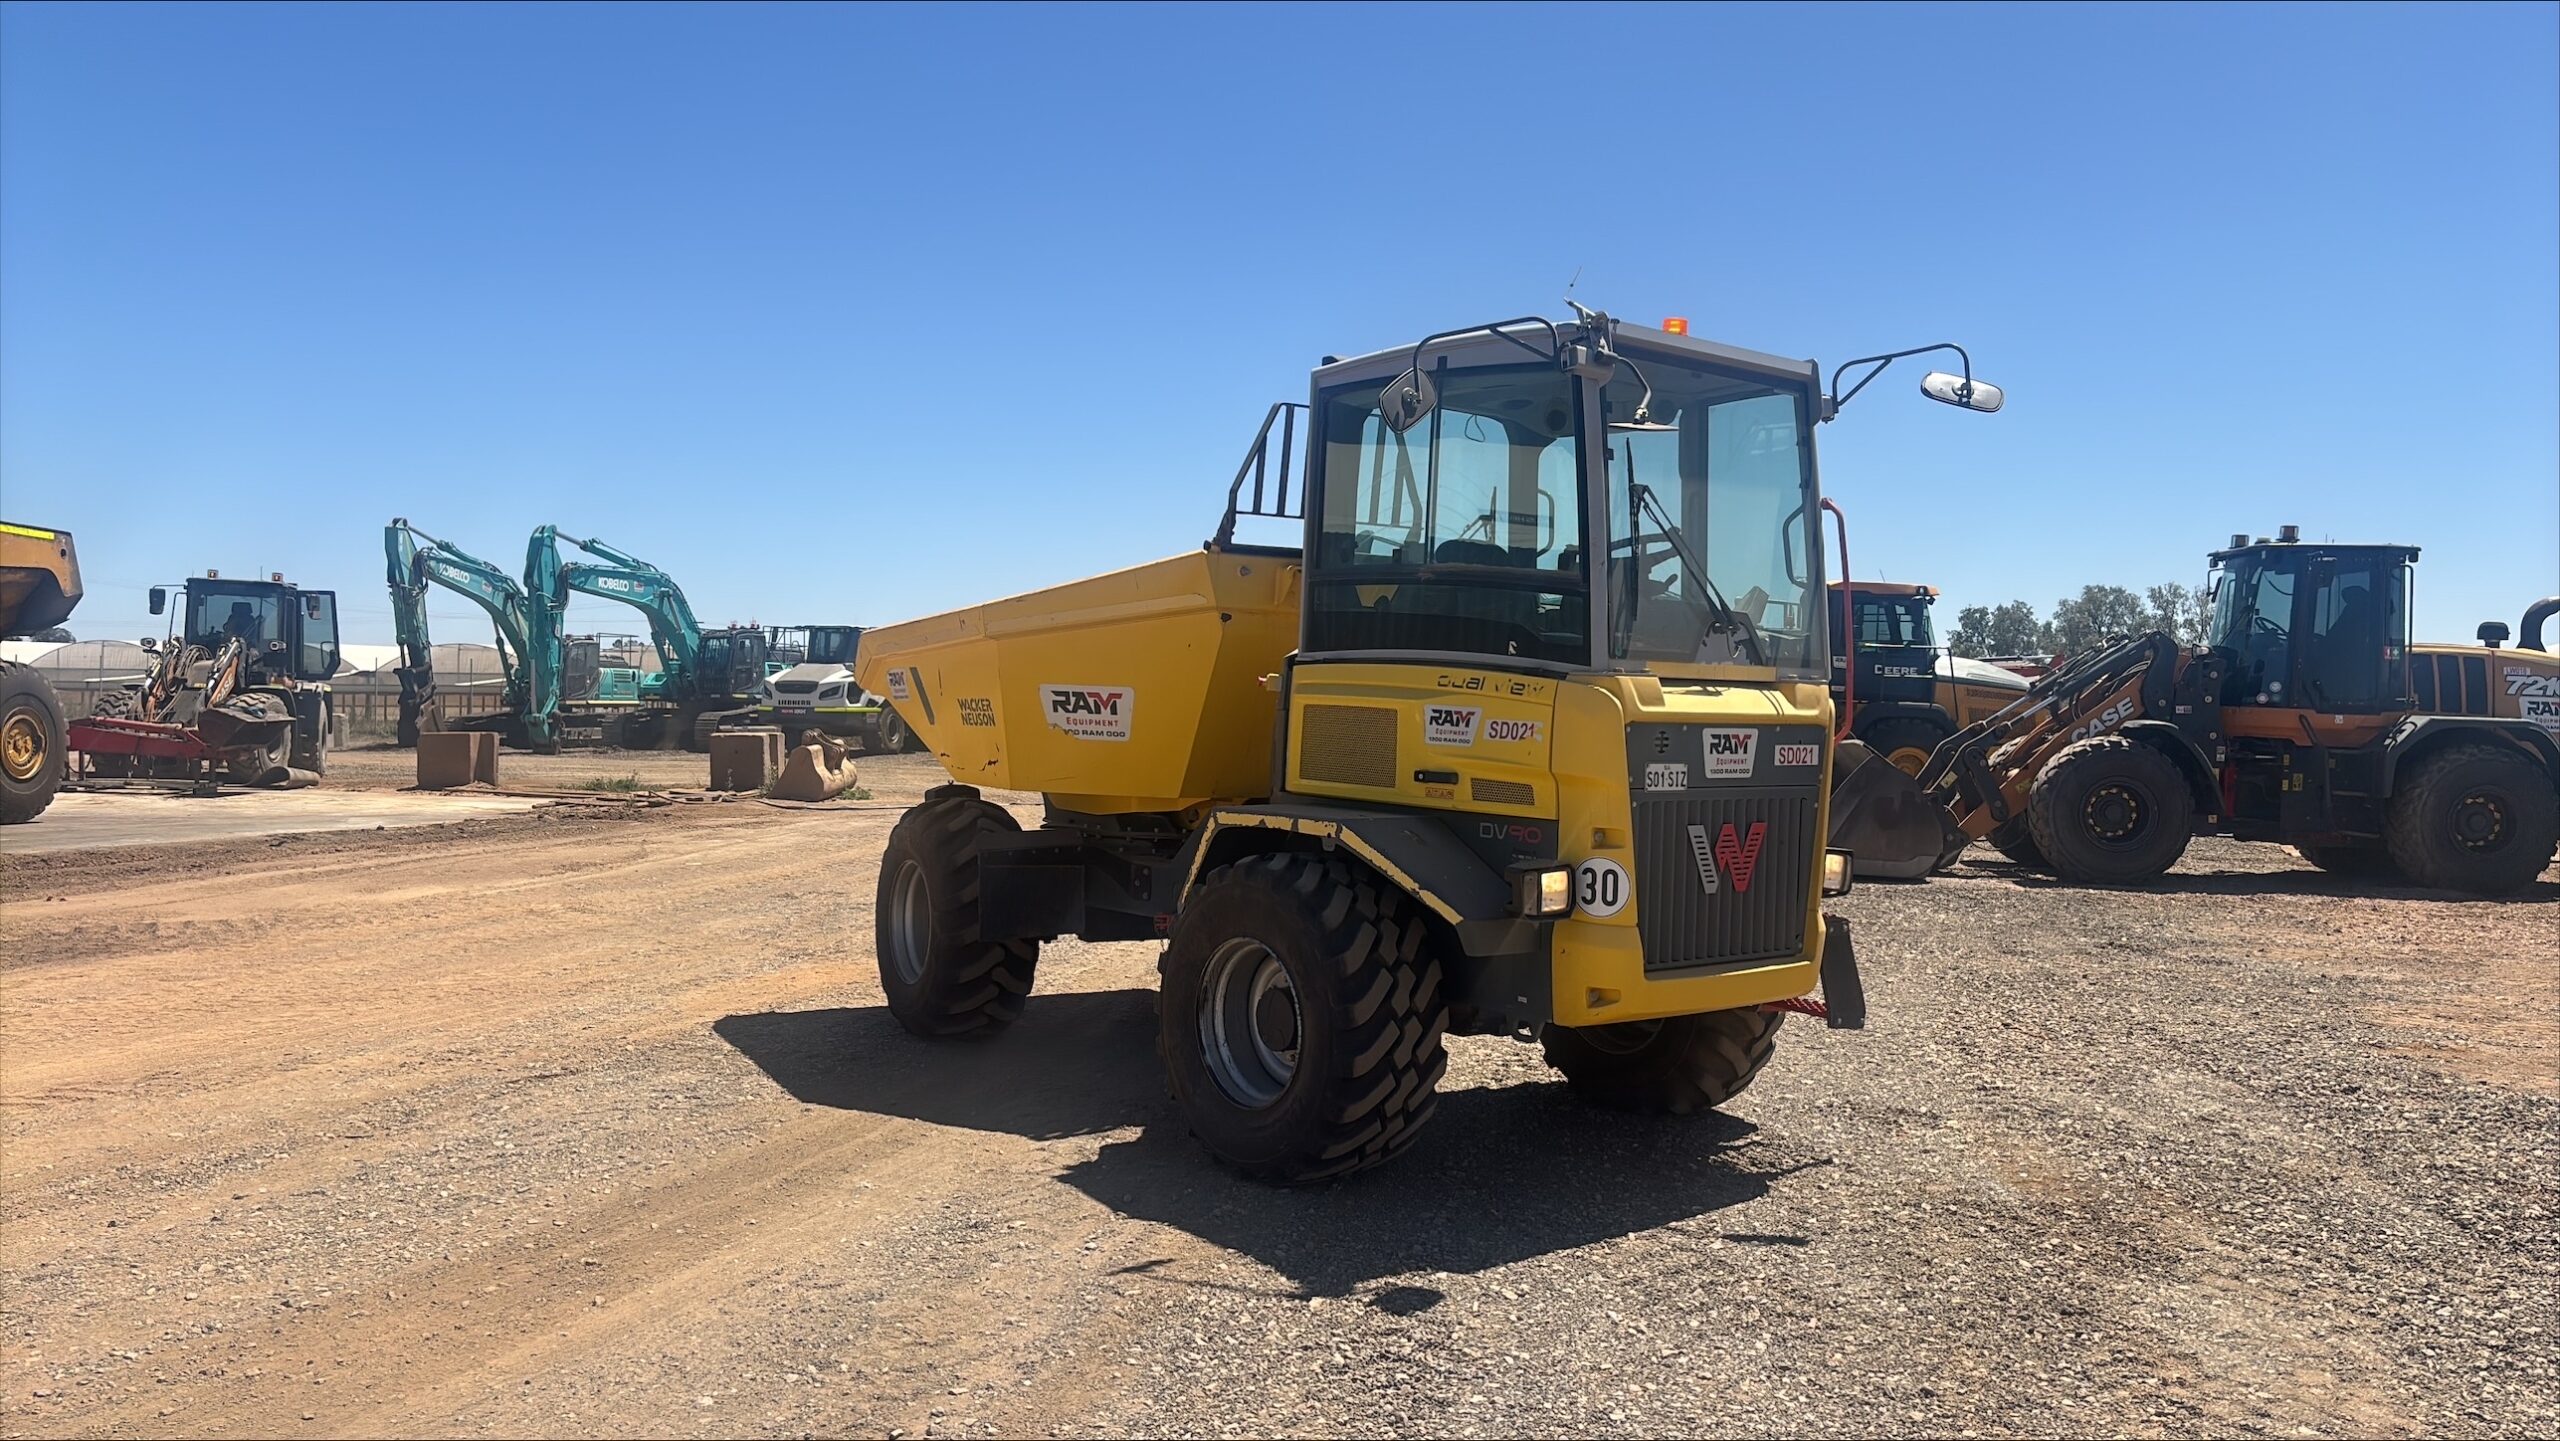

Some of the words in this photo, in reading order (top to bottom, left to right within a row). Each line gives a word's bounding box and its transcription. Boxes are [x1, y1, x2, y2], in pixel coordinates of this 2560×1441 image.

[956, 698, 994, 712] WACKER
[1051, 690, 1123, 716] RAM
[960, 712, 996, 727] NEUSON
[1429, 709, 1476, 728] RAM
[2071, 697, 2135, 743] CASE
[1082, 729, 1105, 737] RAM
[1106, 730, 1126, 738] 000
[1488, 721, 1535, 741] SD021
[1710, 734, 1752, 755] RAM
[1778, 747, 1814, 765] SD021
[1480, 822, 1542, 844] DV90
[1581, 867, 1619, 907] 30
